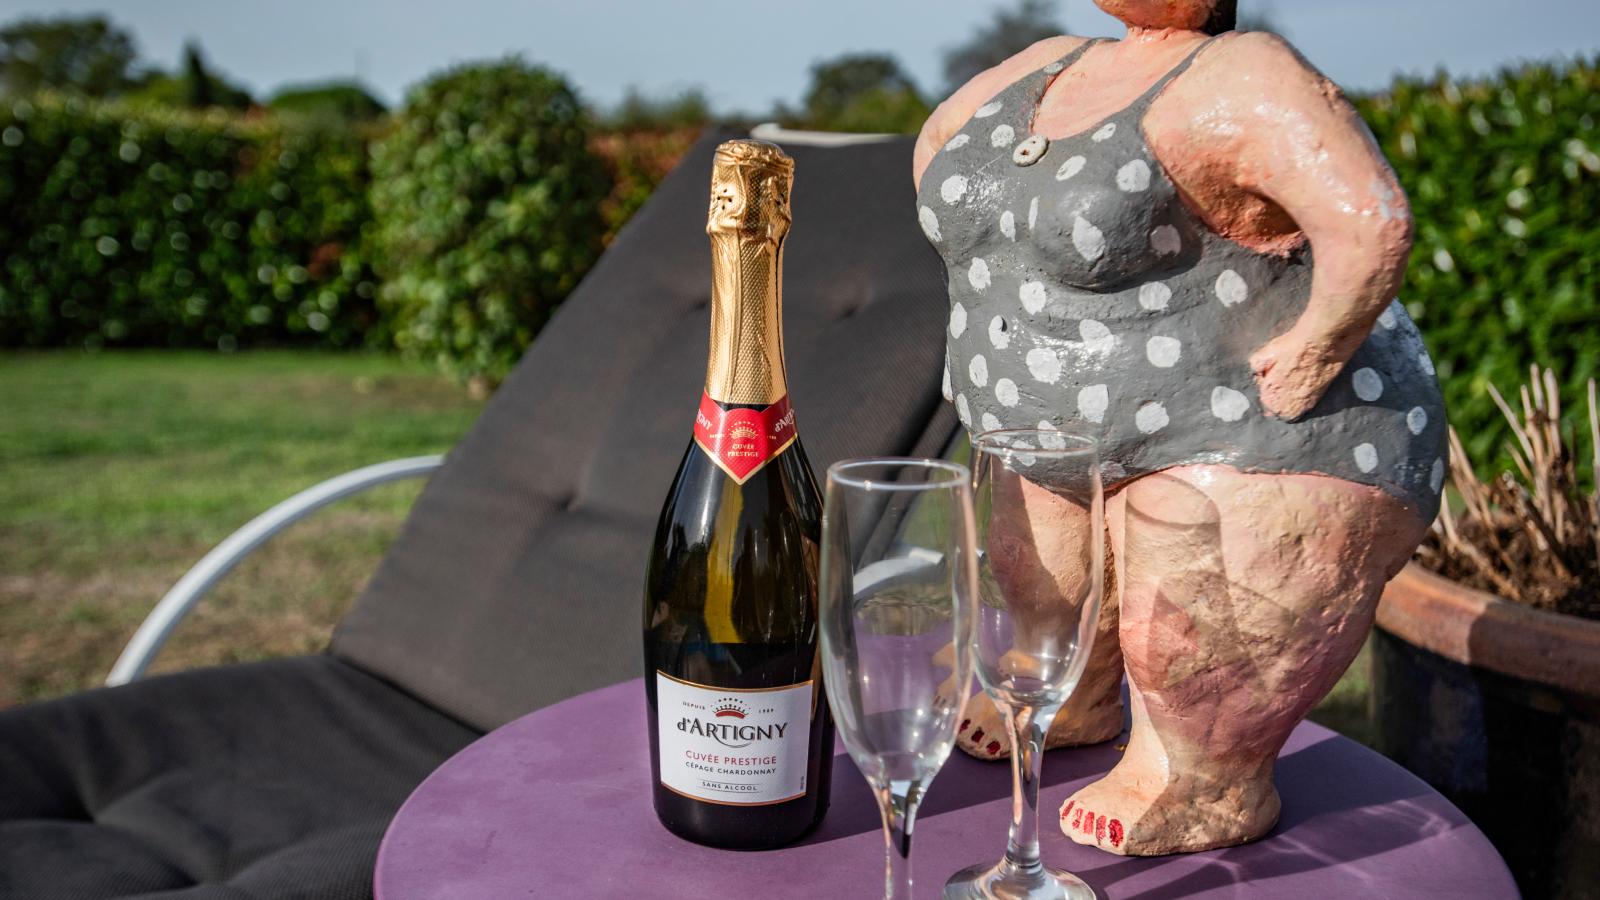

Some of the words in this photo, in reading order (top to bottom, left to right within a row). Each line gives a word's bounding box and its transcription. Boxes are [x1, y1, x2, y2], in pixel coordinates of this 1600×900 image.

[682, 701, 706, 710] DEPUIS
[677, 716, 788, 747] d'ARTIGNY
[685, 750, 720, 764] CUVÉE
[724, 756, 777, 766] PRESTIGE
[685, 761, 714, 773] CÉPAGE
[717, 768, 777, 776] CHARDONNAY
[702, 781, 721, 789] SANS
